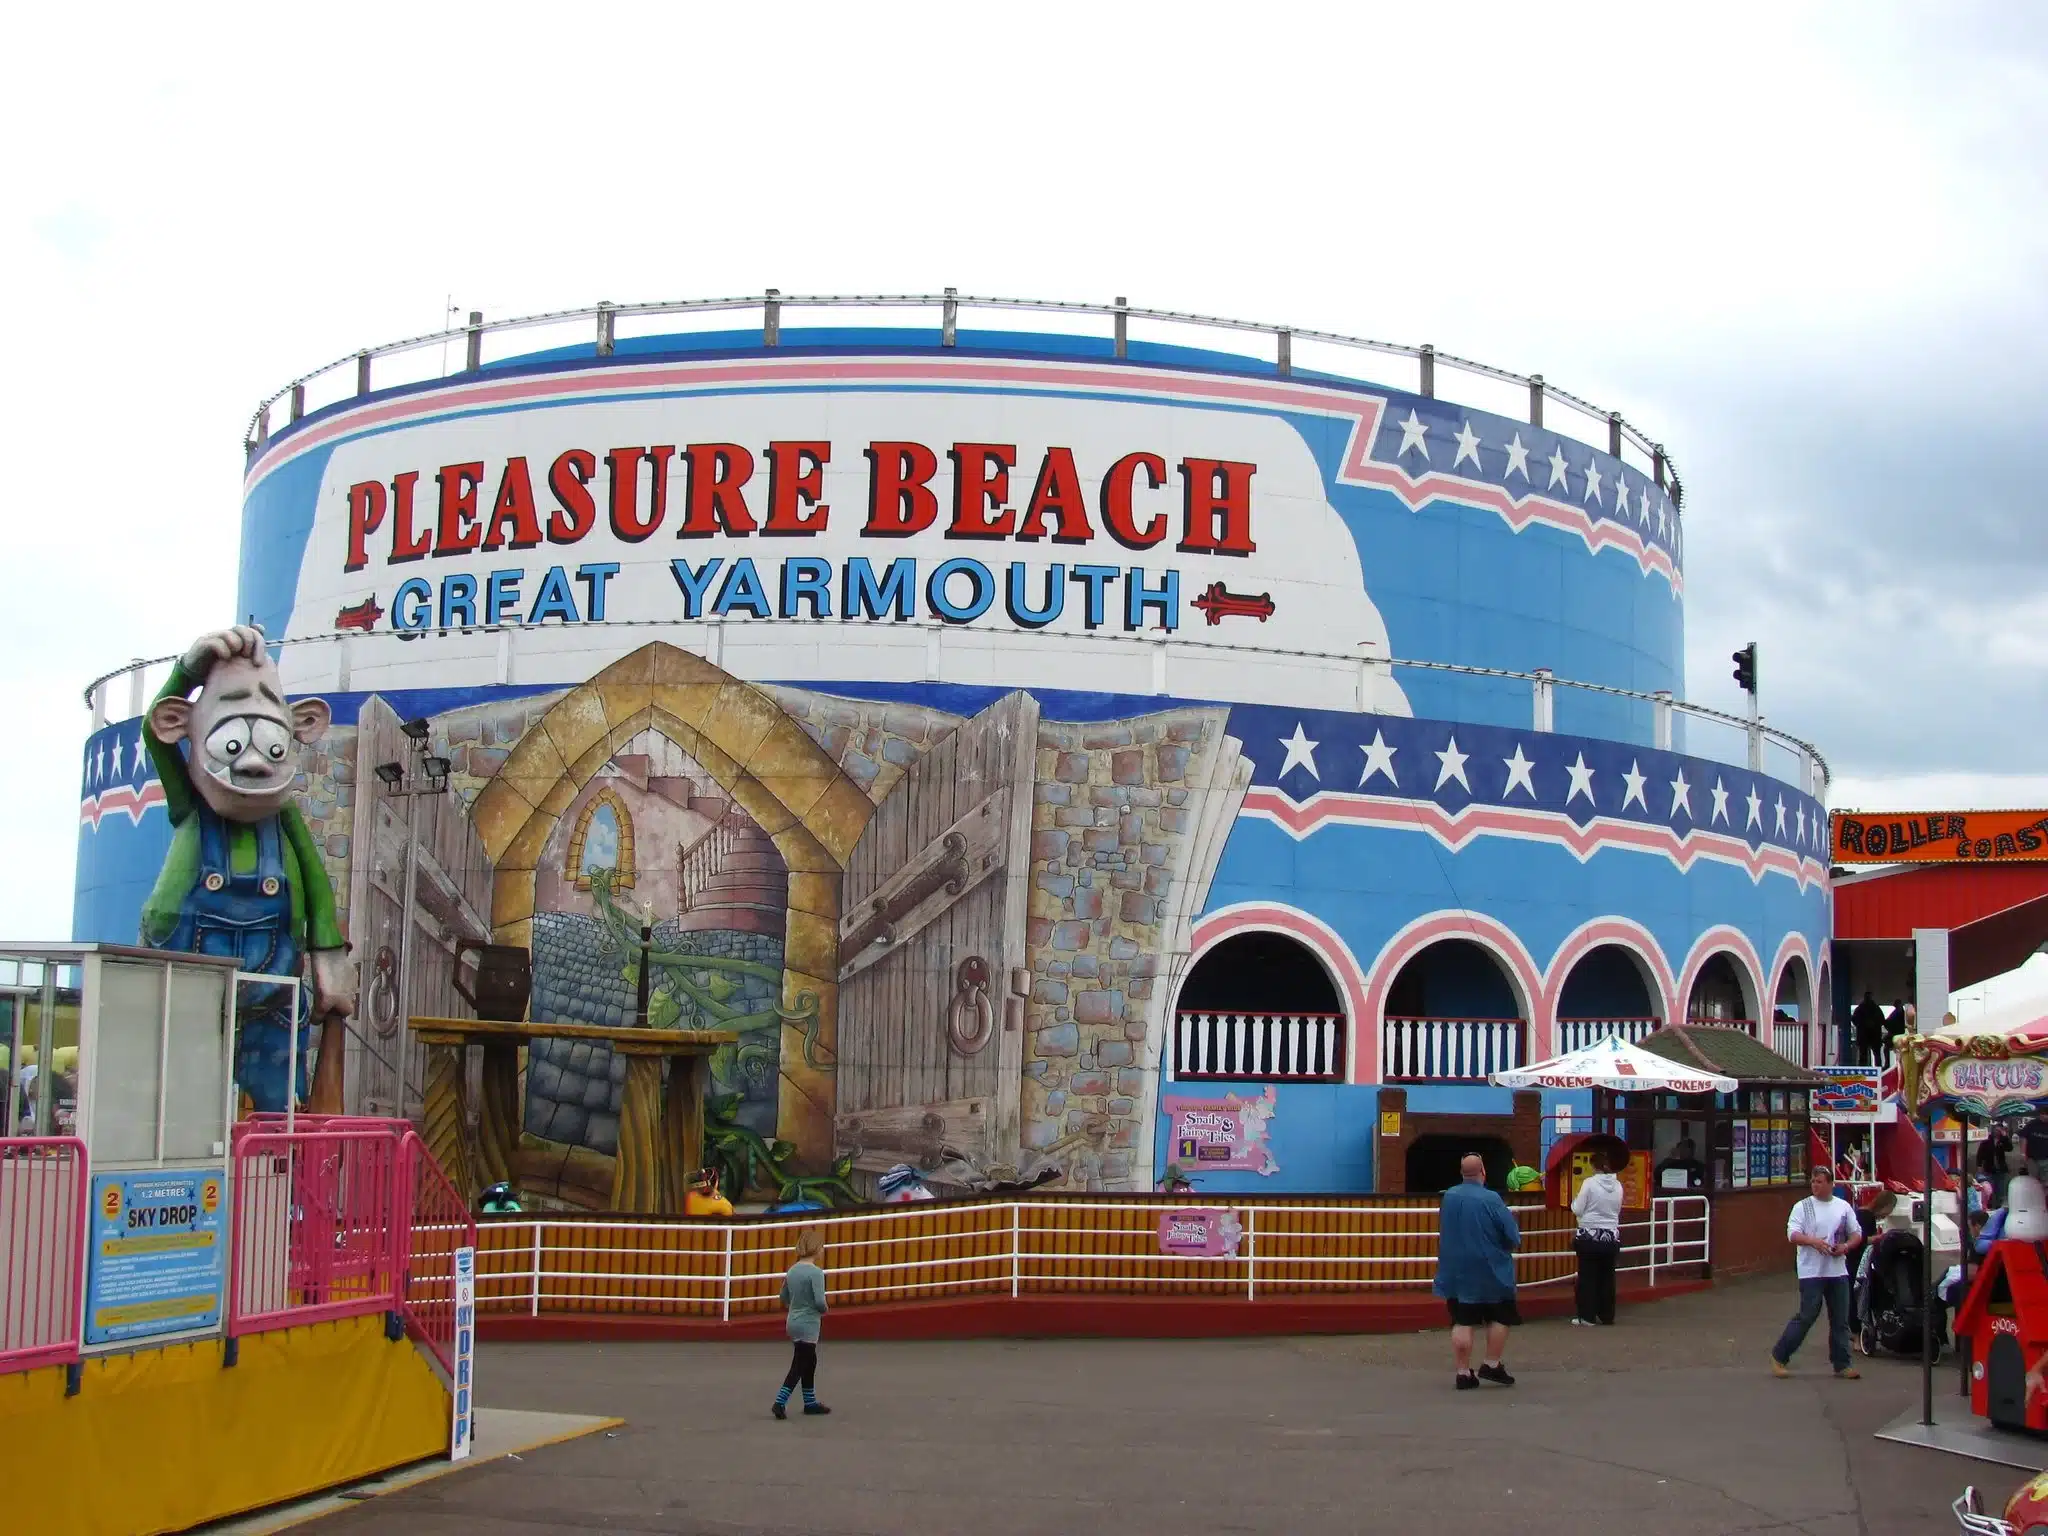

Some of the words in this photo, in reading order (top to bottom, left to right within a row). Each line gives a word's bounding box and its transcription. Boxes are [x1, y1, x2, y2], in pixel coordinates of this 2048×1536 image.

[344, 441, 830, 573] PLEASURE
[860, 441, 1257, 558] BEACH
[391, 562, 620, 641] GREAT
[670, 557, 1180, 633] YARMOUTH
[1840, 815, 1966, 856] ROLLER
[1538, 1076, 1593, 1088] TOKENS
[1666, 1079, 1712, 1091] TOKENS
[1185, 1112, 1221, 1125] Snails
[1221, 1118, 1234, 1133] &
[1177, 1125, 1208, 1140] Fairy
[1208, 1131, 1235, 1144] Tales
[1183, 1141, 1192, 1156] 1
[107, 1193, 119, 1207] 2
[141, 1190, 153, 1199] 1.2
[154, 1188, 186, 1198] METRES
[206, 1186, 217, 1199] 2
[128, 1207, 157, 1228] SKY
[159, 1205, 198, 1226] DROP
[1992, 1318, 2020, 1336] SNOOPY
